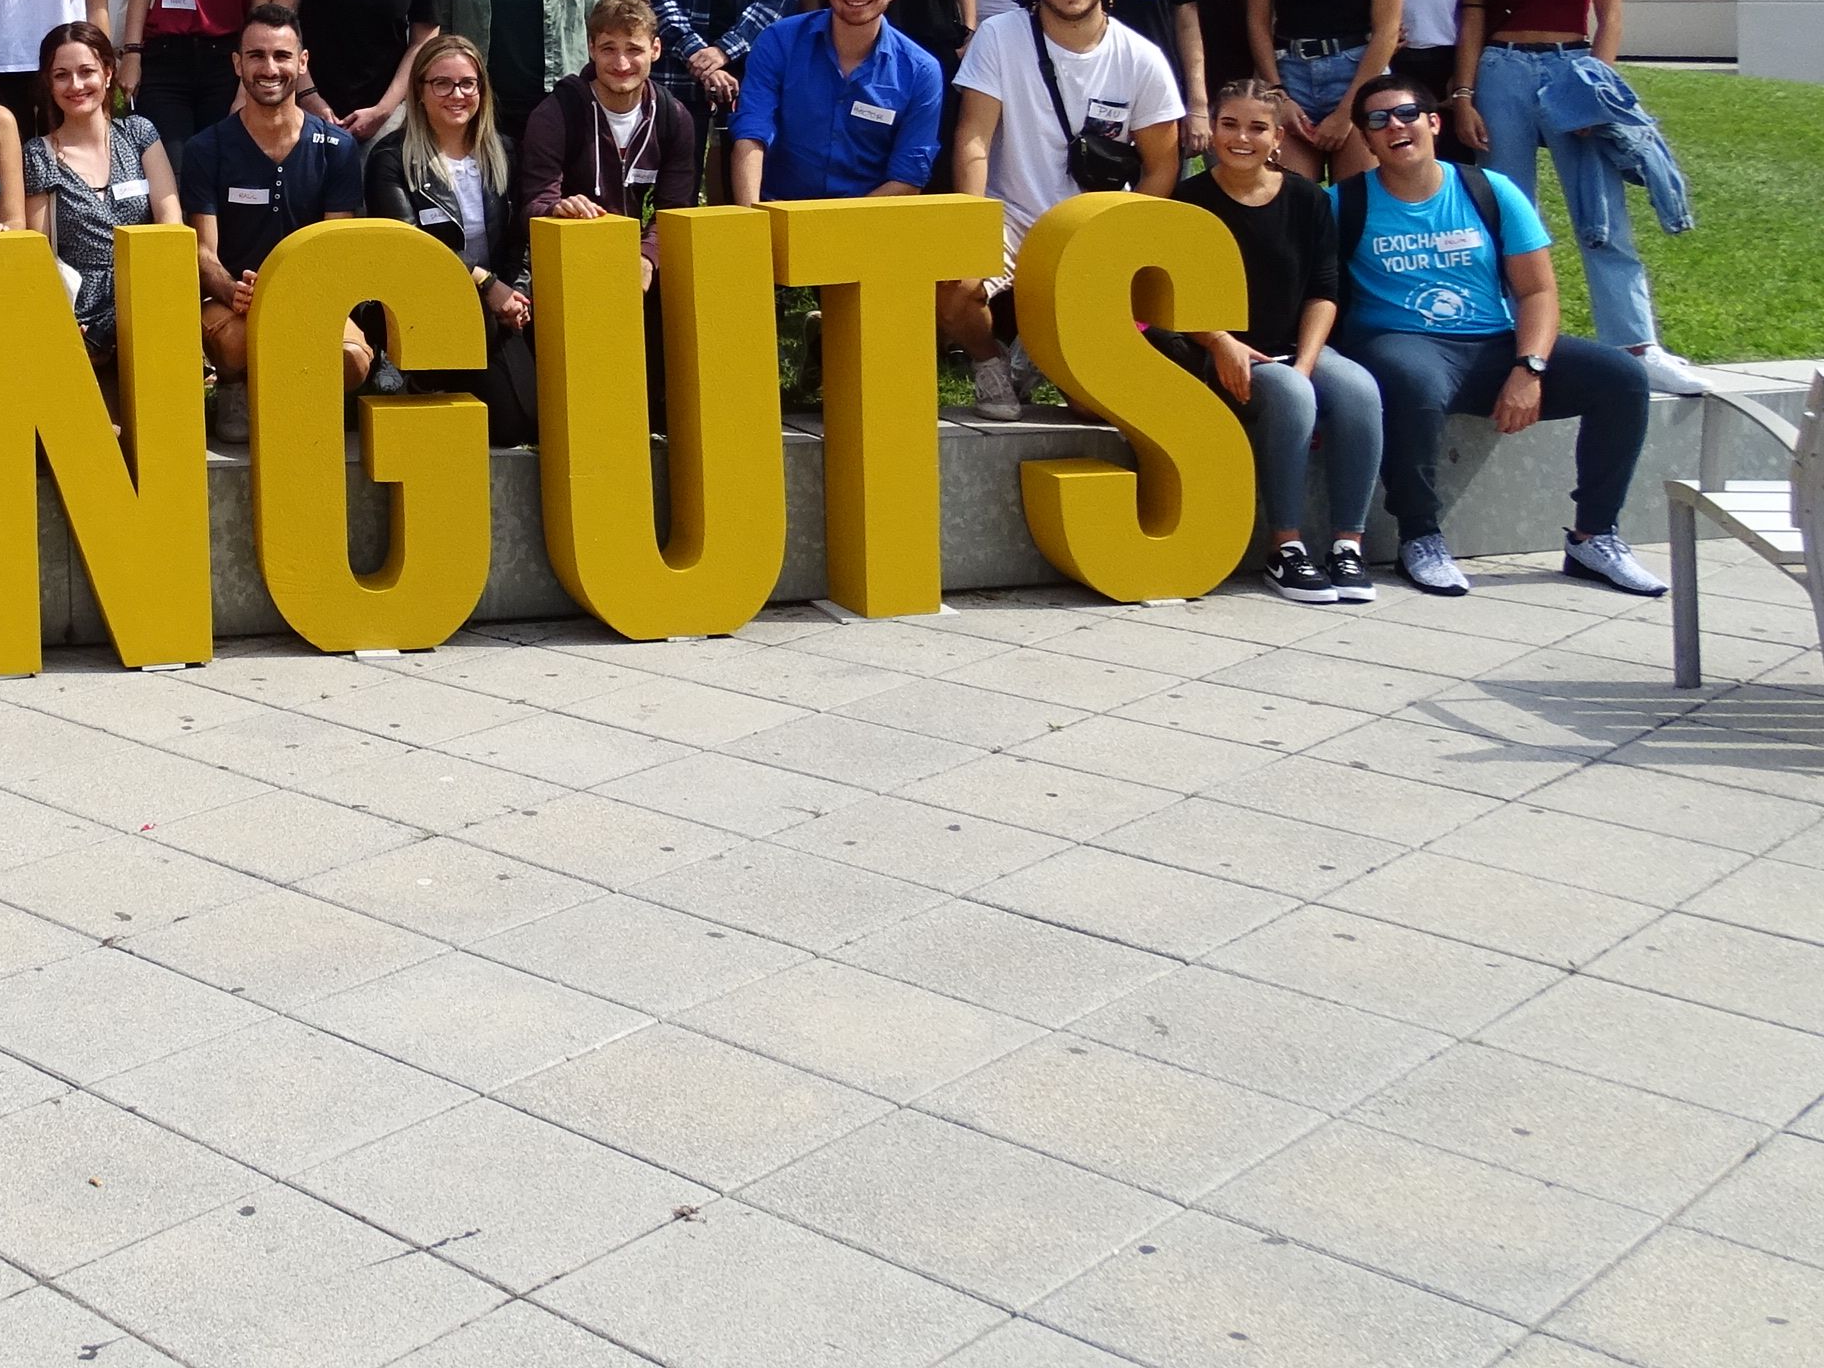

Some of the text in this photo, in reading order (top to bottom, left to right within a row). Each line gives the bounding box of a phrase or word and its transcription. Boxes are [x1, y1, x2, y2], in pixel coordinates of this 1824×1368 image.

[1098, 105, 1121, 118] PAU
[1381, 251, 1473, 273] YOUR LIFE
